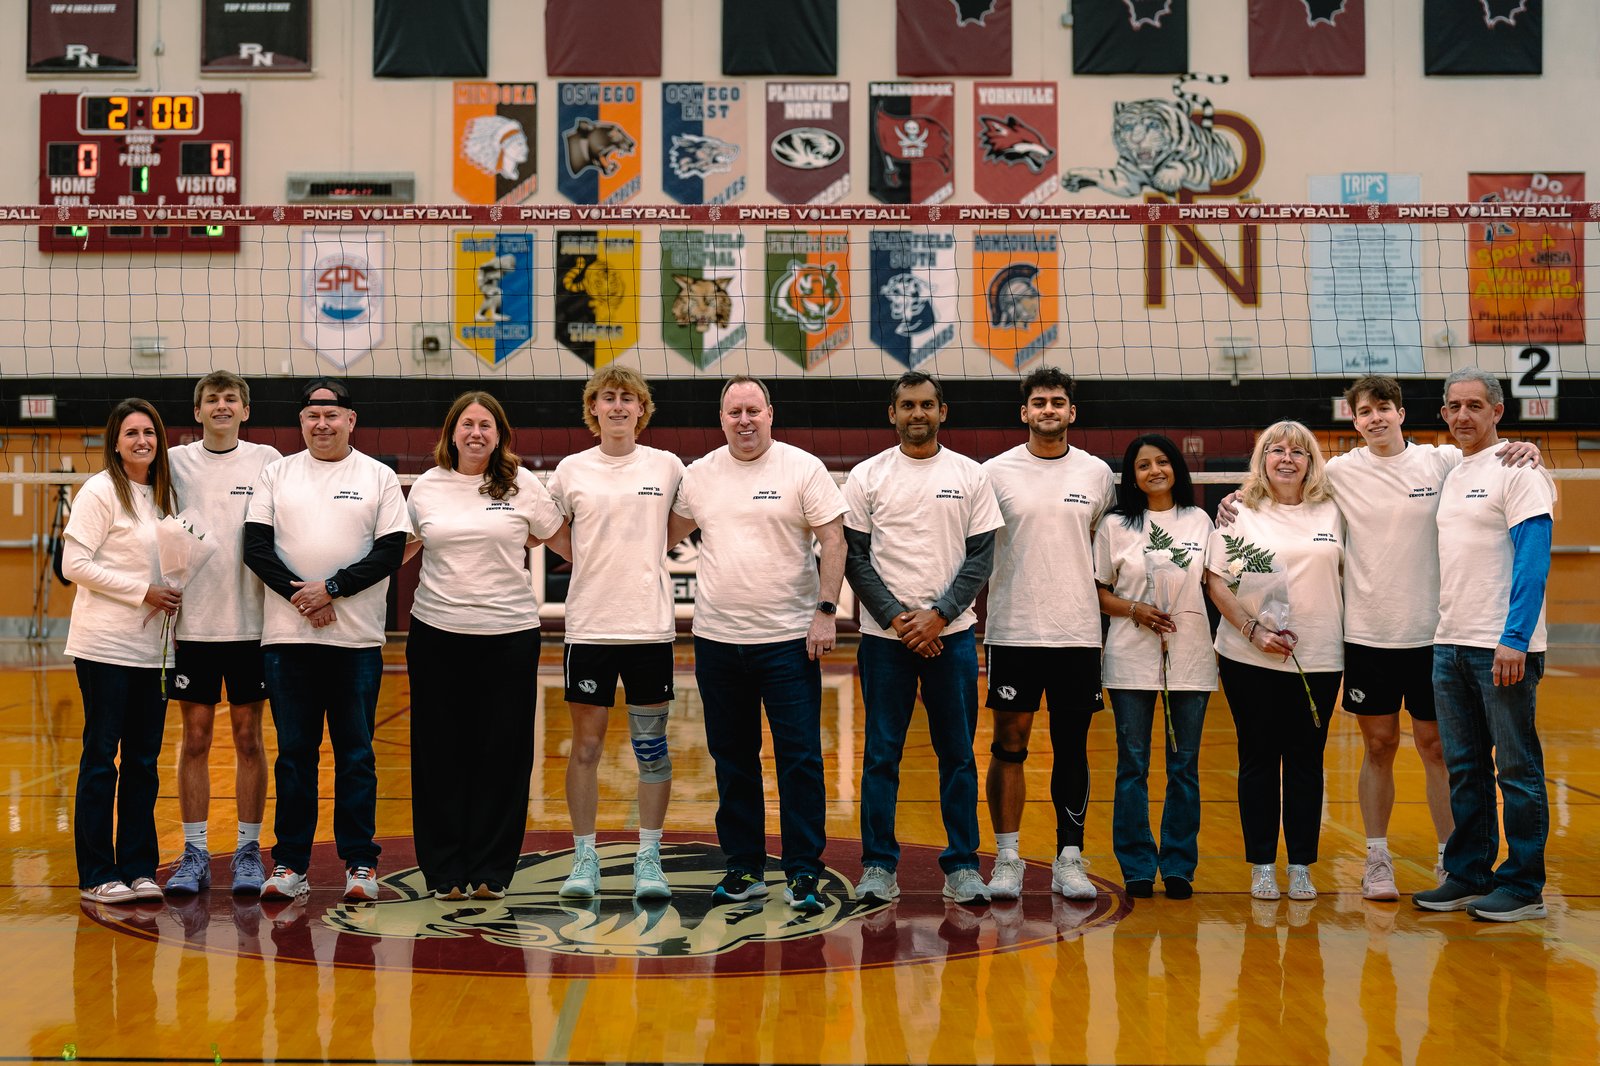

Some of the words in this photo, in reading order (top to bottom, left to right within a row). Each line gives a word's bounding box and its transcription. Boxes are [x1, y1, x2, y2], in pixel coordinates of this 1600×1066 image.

[50, 3, 67, 13] TOP
[67, 4, 72, 13] 4
[93, 4, 117, 13] STATE
[224, 2, 240, 12] TOP
[267, 2, 291, 12] STATE
[562, 84, 637, 105] OSWEGO
[666, 84, 741, 104] OSWEGO
[767, 84, 849, 102] PLAINFIELD
[977, 86, 1055, 105] YORKVILLE
[681, 103, 729, 120] EAST
[784, 102, 833, 120] NORTH
[78, 143, 98, 177] 0
[119, 154, 161, 166] PERIOD
[210, 143, 231, 176] 0
[51, 177, 96, 194] HOME
[141, 166, 149, 193] 1
[176, 177, 237, 194] VISITOR
[1530, 173, 1563, 194] Do
[54, 196, 90, 206] FOULS
[188, 196, 224, 206] FOULS
[87, 208, 138, 220] PNHS
[303, 208, 353, 220] PNHS
[520, 208, 571, 220] PNHS
[739, 208, 790, 220] PNHS
[959, 208, 1010, 220] PNHS
[1179, 208, 1230, 219] PNHS
[1398, 206, 1450, 218] PNHS
[889, 250, 936, 268] SOUTH
[1475, 239, 1535, 264] Sport
[1485, 267, 1571, 284] Winning
[1478, 311, 1534, 322] Plainfield
[1492, 324, 1520, 336] High
[1525, 324, 1564, 336] School
[1518, 347, 1551, 386] 2
[27, 399, 48, 414] EXIT
[1528, 401, 1550, 416] EXIT
